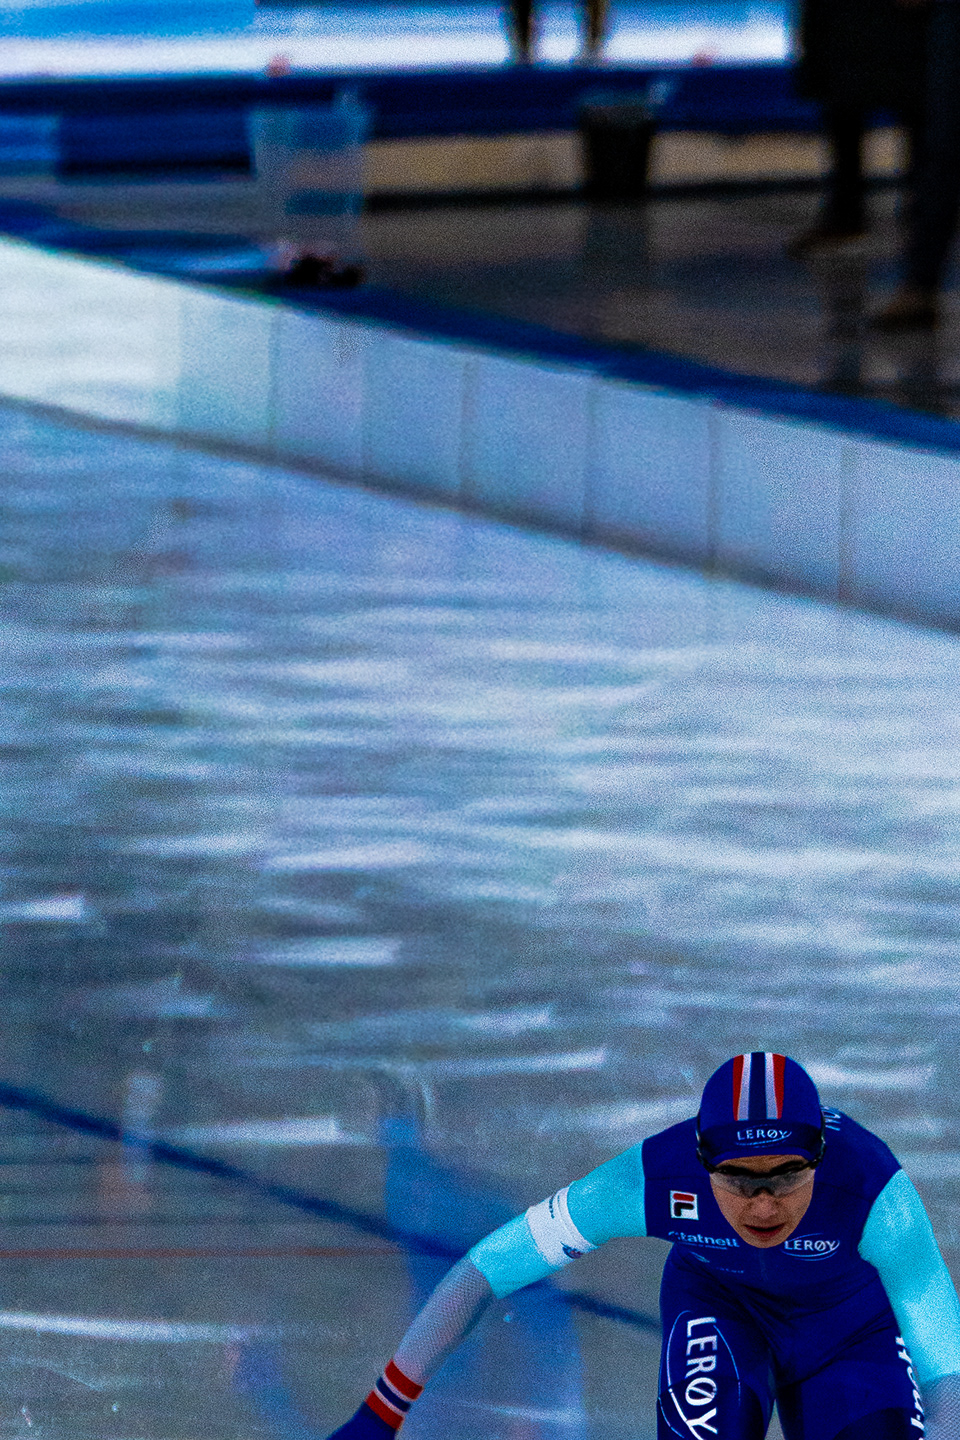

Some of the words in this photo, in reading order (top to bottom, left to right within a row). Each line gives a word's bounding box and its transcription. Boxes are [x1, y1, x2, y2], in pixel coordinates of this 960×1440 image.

[736, 1128, 789, 1141] LERØY
[784, 1239, 837, 1251] LERØY
[685, 1315, 718, 1436] LERØY
